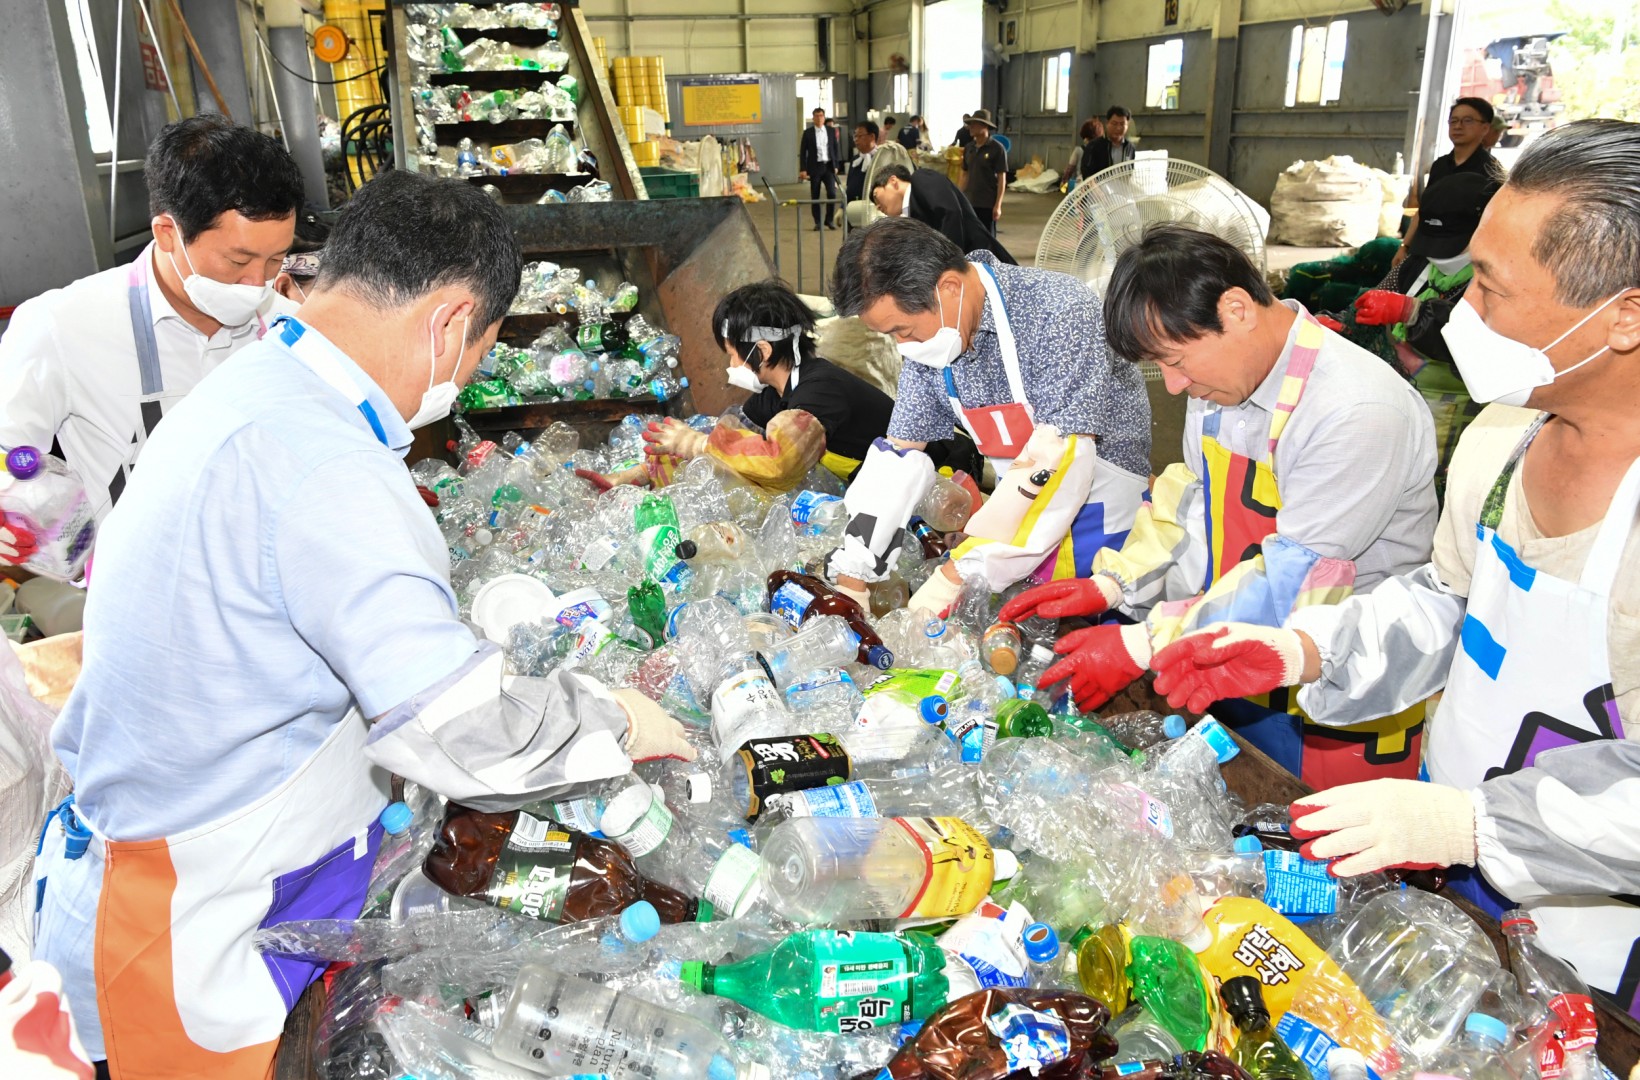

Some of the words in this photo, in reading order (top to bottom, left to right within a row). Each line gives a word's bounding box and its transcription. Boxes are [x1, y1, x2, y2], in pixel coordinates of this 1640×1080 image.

[519, 864, 556, 920] Egge
[1233, 923, 1281, 967] 비락
[1256, 944, 1305, 986] 식혜
[840, 998, 891, 1033] 생탁
[589, 1036, 606, 1066] plan
[597, 1029, 622, 1074] Natura
